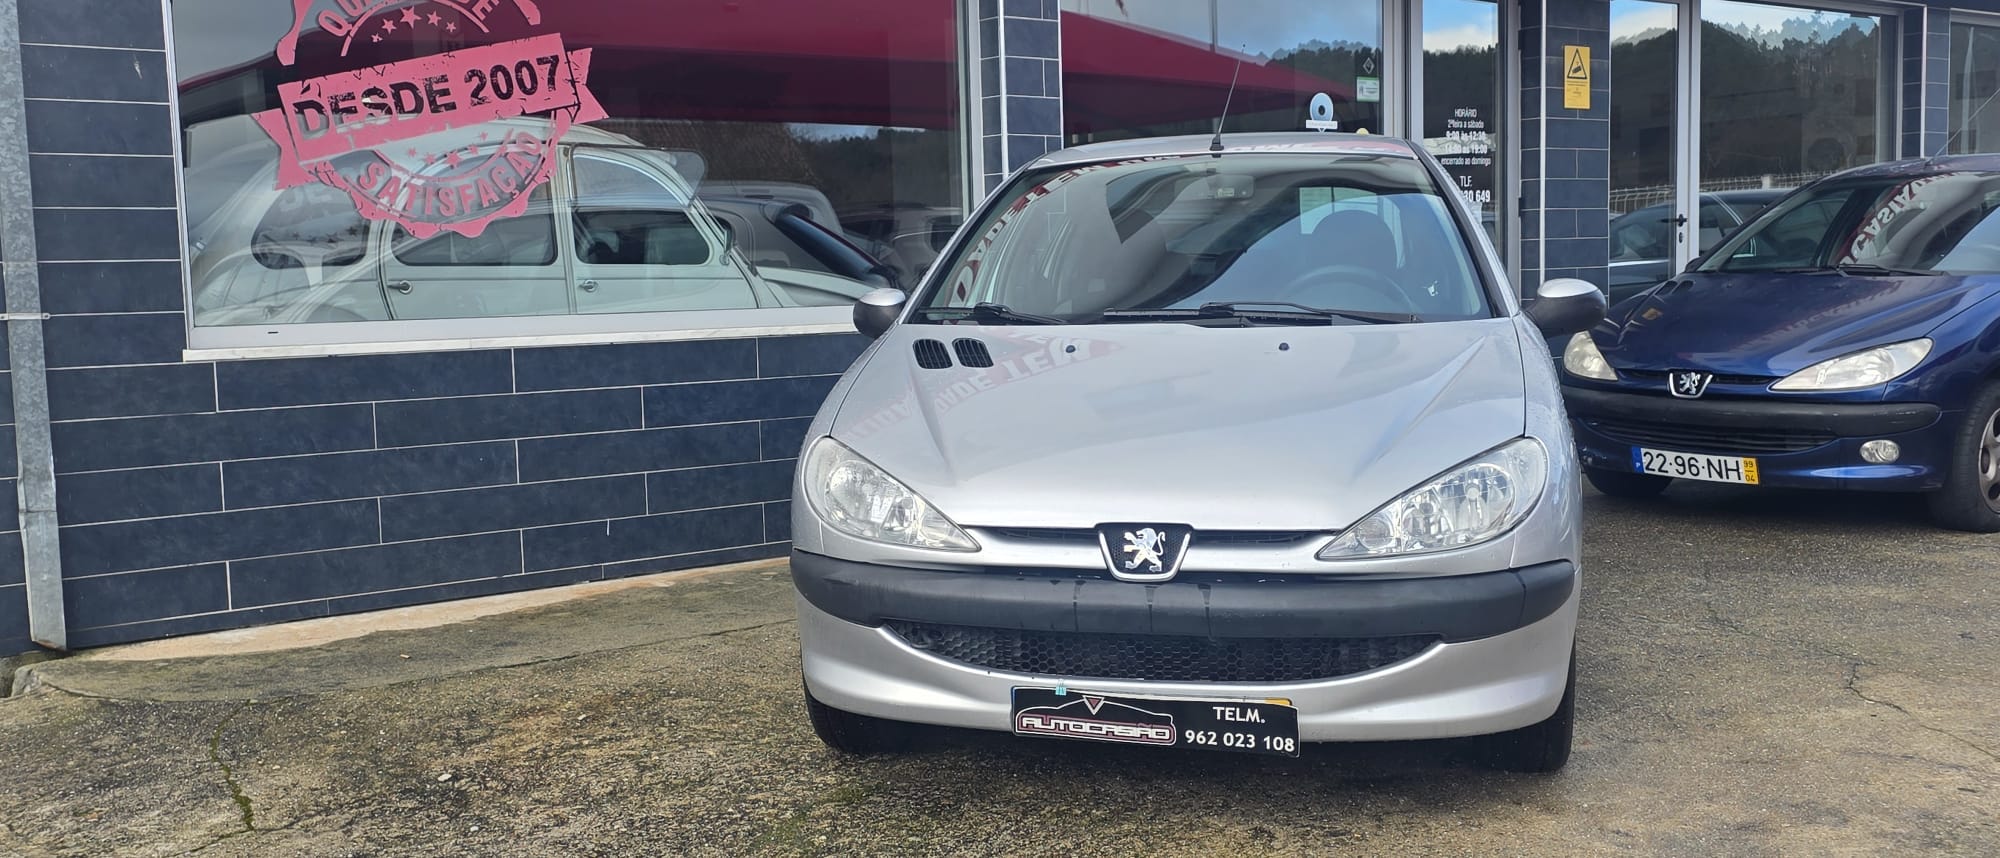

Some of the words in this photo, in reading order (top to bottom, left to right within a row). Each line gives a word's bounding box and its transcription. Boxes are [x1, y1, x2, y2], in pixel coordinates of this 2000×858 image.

[292, 74, 457, 140] DESDE
[464, 54, 560, 107] 2007
[1475, 189, 1491, 203] 649
[1744, 474, 1756, 482] 04
[1212, 706, 1266, 724] TELM.
[1021, 716, 1171, 740] AUTOCASIÃO
[1184, 729, 1218, 746] 962
[1222, 732, 1256, 748] 023
[1263, 735, 1296, 752] 108
